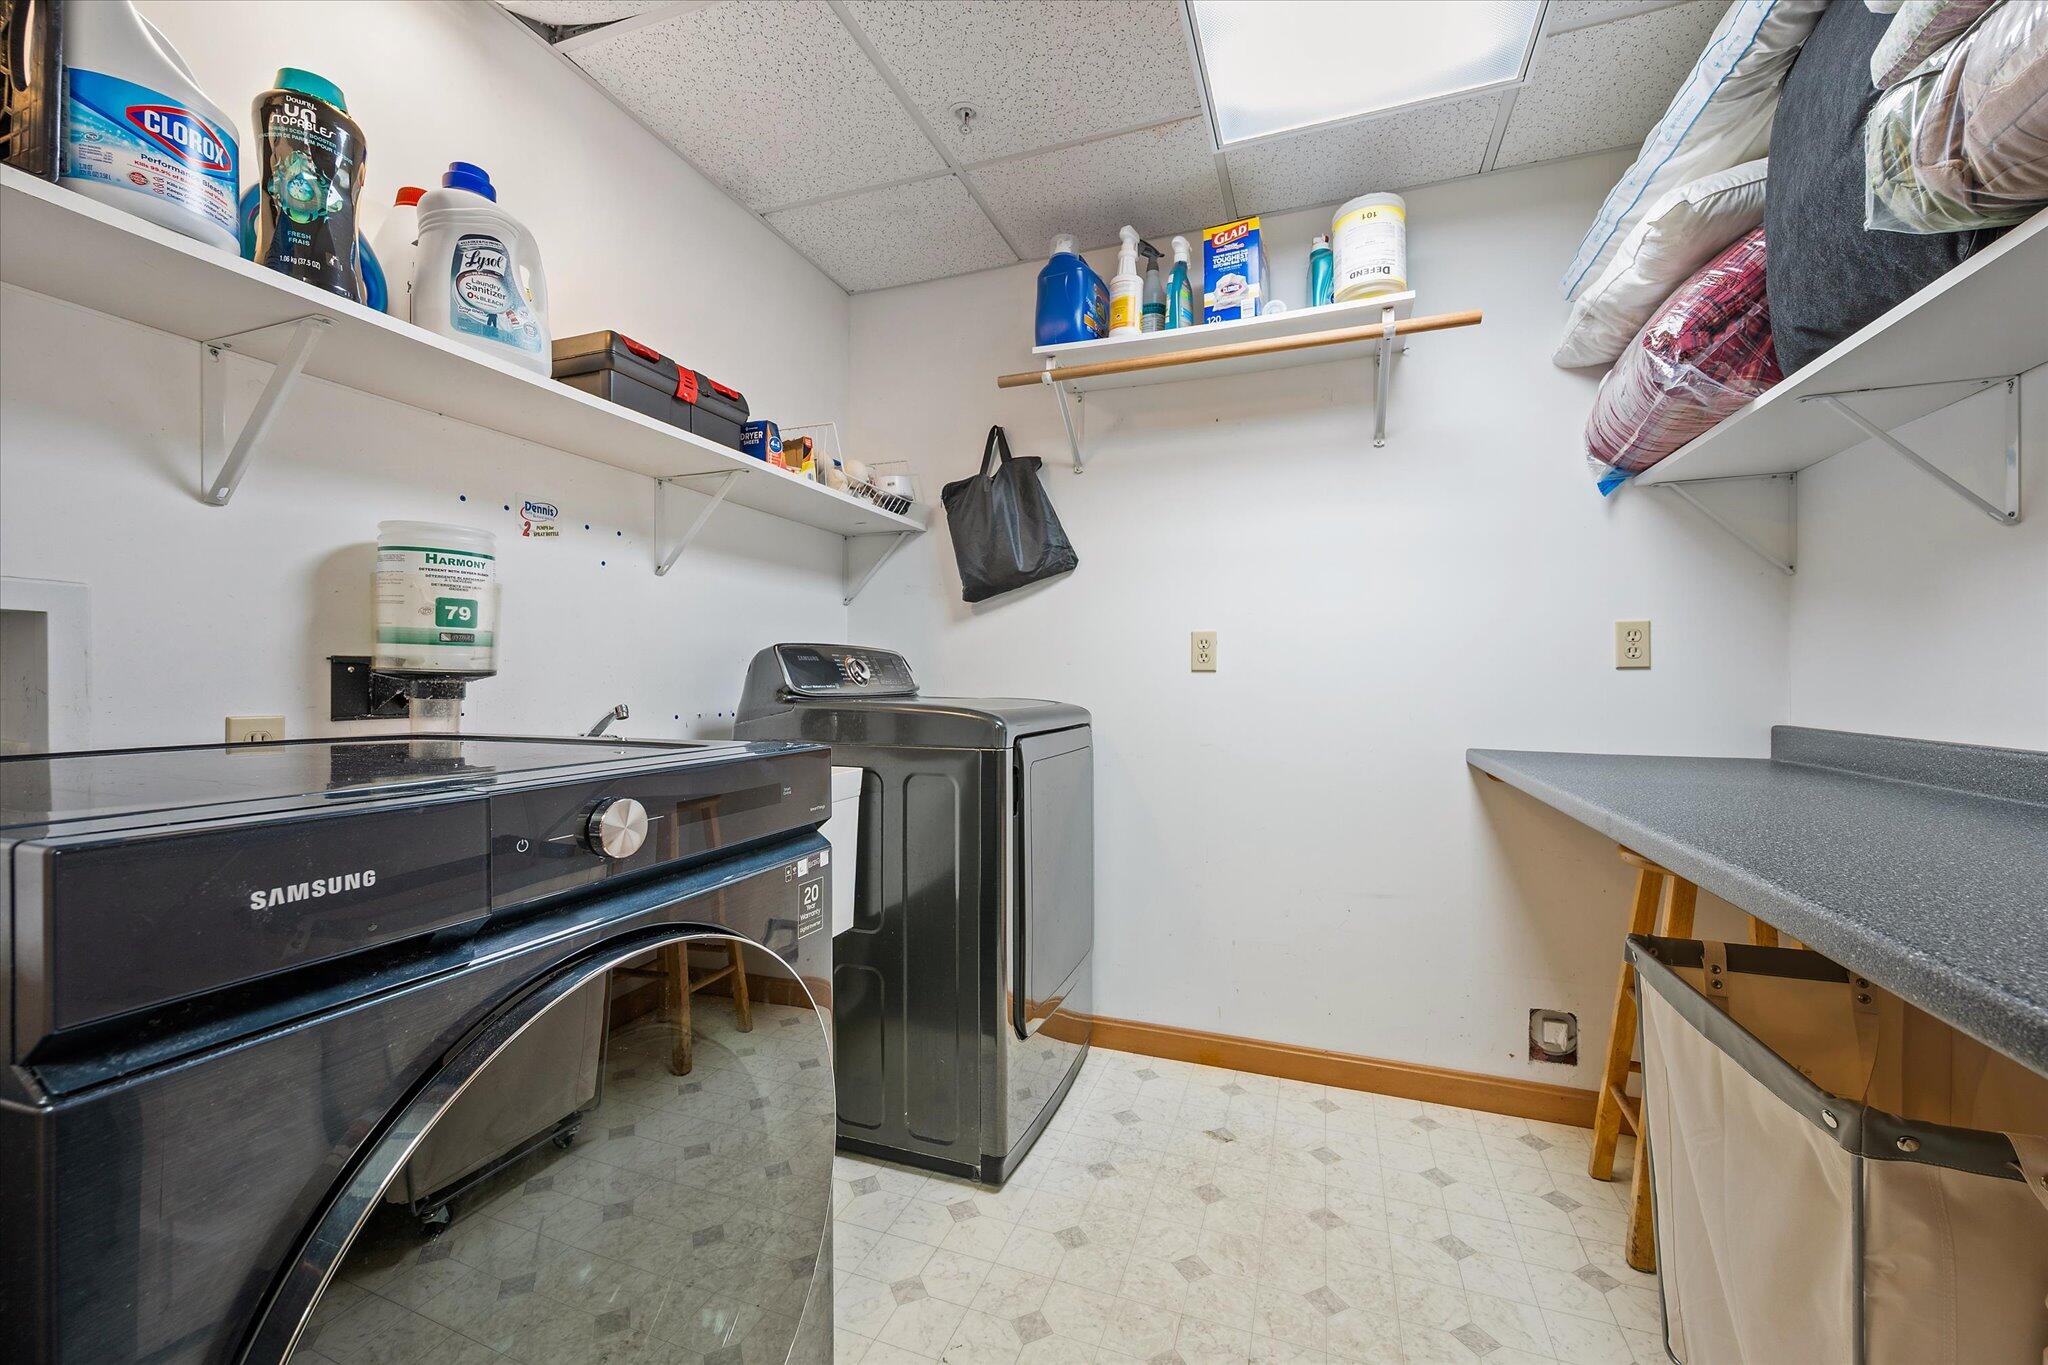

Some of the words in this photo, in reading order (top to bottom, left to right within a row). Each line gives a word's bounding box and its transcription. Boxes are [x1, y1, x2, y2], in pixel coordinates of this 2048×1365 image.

[286, 95, 317, 110] Downy
[144, 109, 225, 168] CLOROX
[1362, 211, 1377, 220] 101
[287, 230, 311, 240] FRESH
[1213, 224, 1248, 245] GLAD
[288, 237, 310, 247] FRAIS
[290, 256, 298, 265] kg
[465, 249, 504, 270] Lysol
[1212, 252, 1248, 265] TOUGHEST
[1349, 266, 1391, 279] DEFEND
[465, 282, 507, 300] Sanitizer
[471, 278, 501, 291] Laundry
[1207, 316, 1222, 324] 120
[740, 430, 763, 440] DRYER
[524, 501, 554, 516] Dennis
[522, 520, 531, 537] 2
[444, 606, 471, 621] 79
[250, 869, 376, 911] SAMSUNG
[804, 884, 819, 905] 20
[800, 908, 822, 921] Warranty
